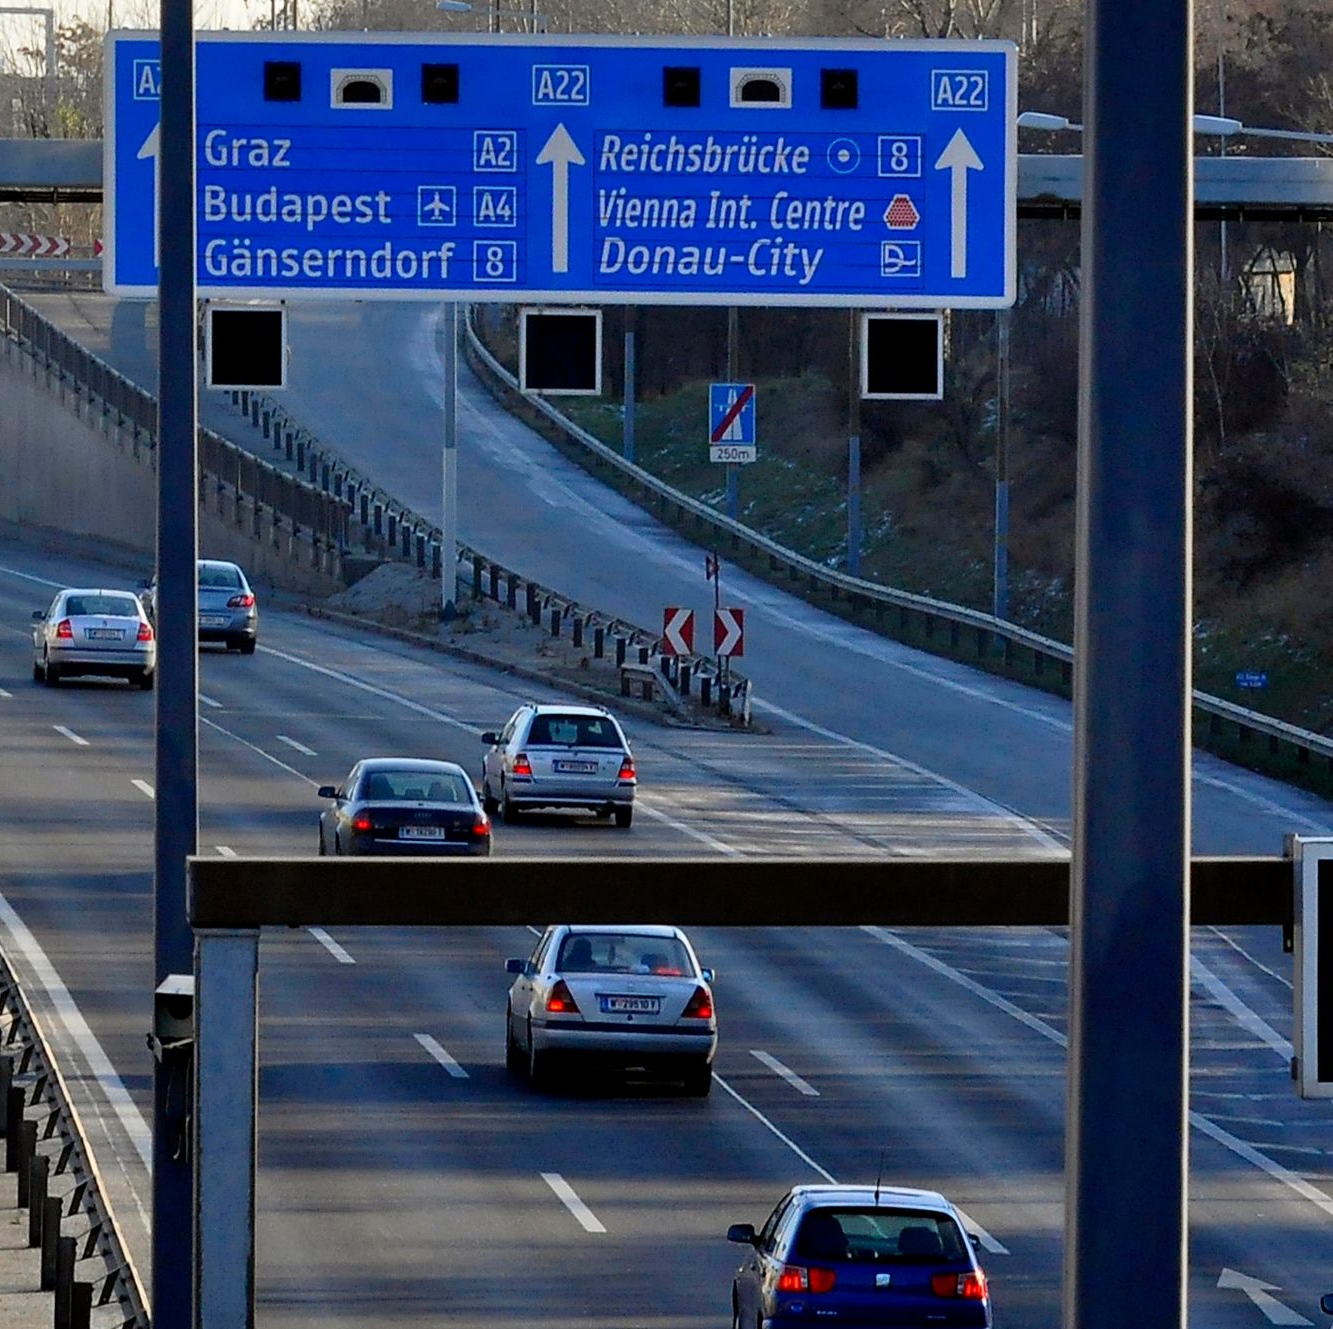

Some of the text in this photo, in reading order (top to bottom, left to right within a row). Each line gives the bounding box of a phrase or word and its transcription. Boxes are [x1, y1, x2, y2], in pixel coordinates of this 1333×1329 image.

[538, 70, 584, 100] A22
[937, 76, 983, 105] A22
[205, 130, 511, 167] Graz A2
[600, 134, 908, 174] Reichsbrücke 8
[205, 186, 511, 230] Budapest A4
[599, 188, 865, 230] Vienna Int. Centre
[205, 239, 504, 279] Gänserndorf 8
[600, 239, 823, 284] Donau-City
[717, 447, 750, 460] 250m
